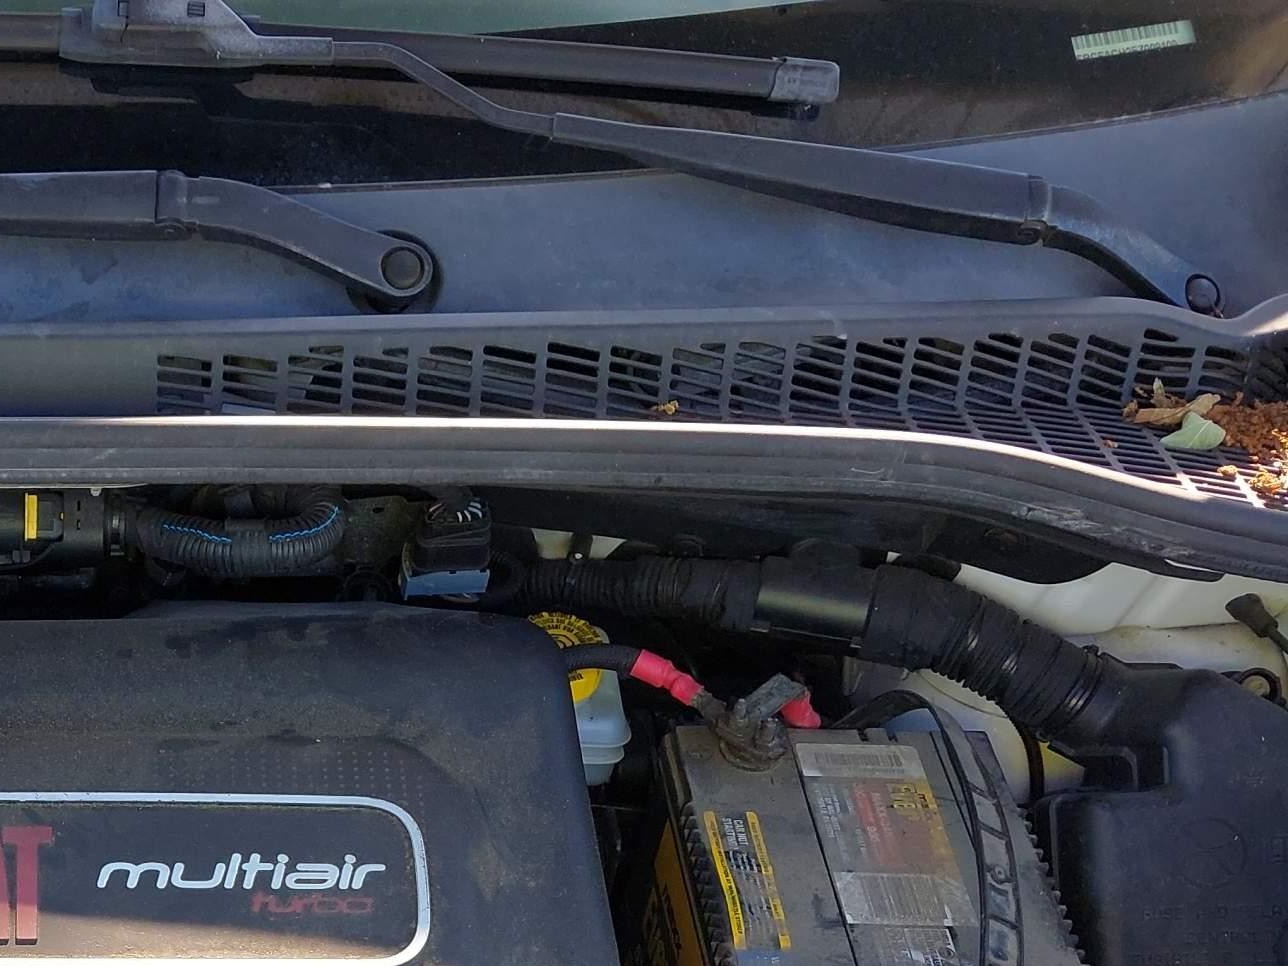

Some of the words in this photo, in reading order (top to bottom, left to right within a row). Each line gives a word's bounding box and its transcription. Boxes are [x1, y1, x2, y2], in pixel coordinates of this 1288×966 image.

[737, 832, 749, 847] NOT
[96, 853, 386, 889] multiair
[250, 889, 375, 917] turbo
